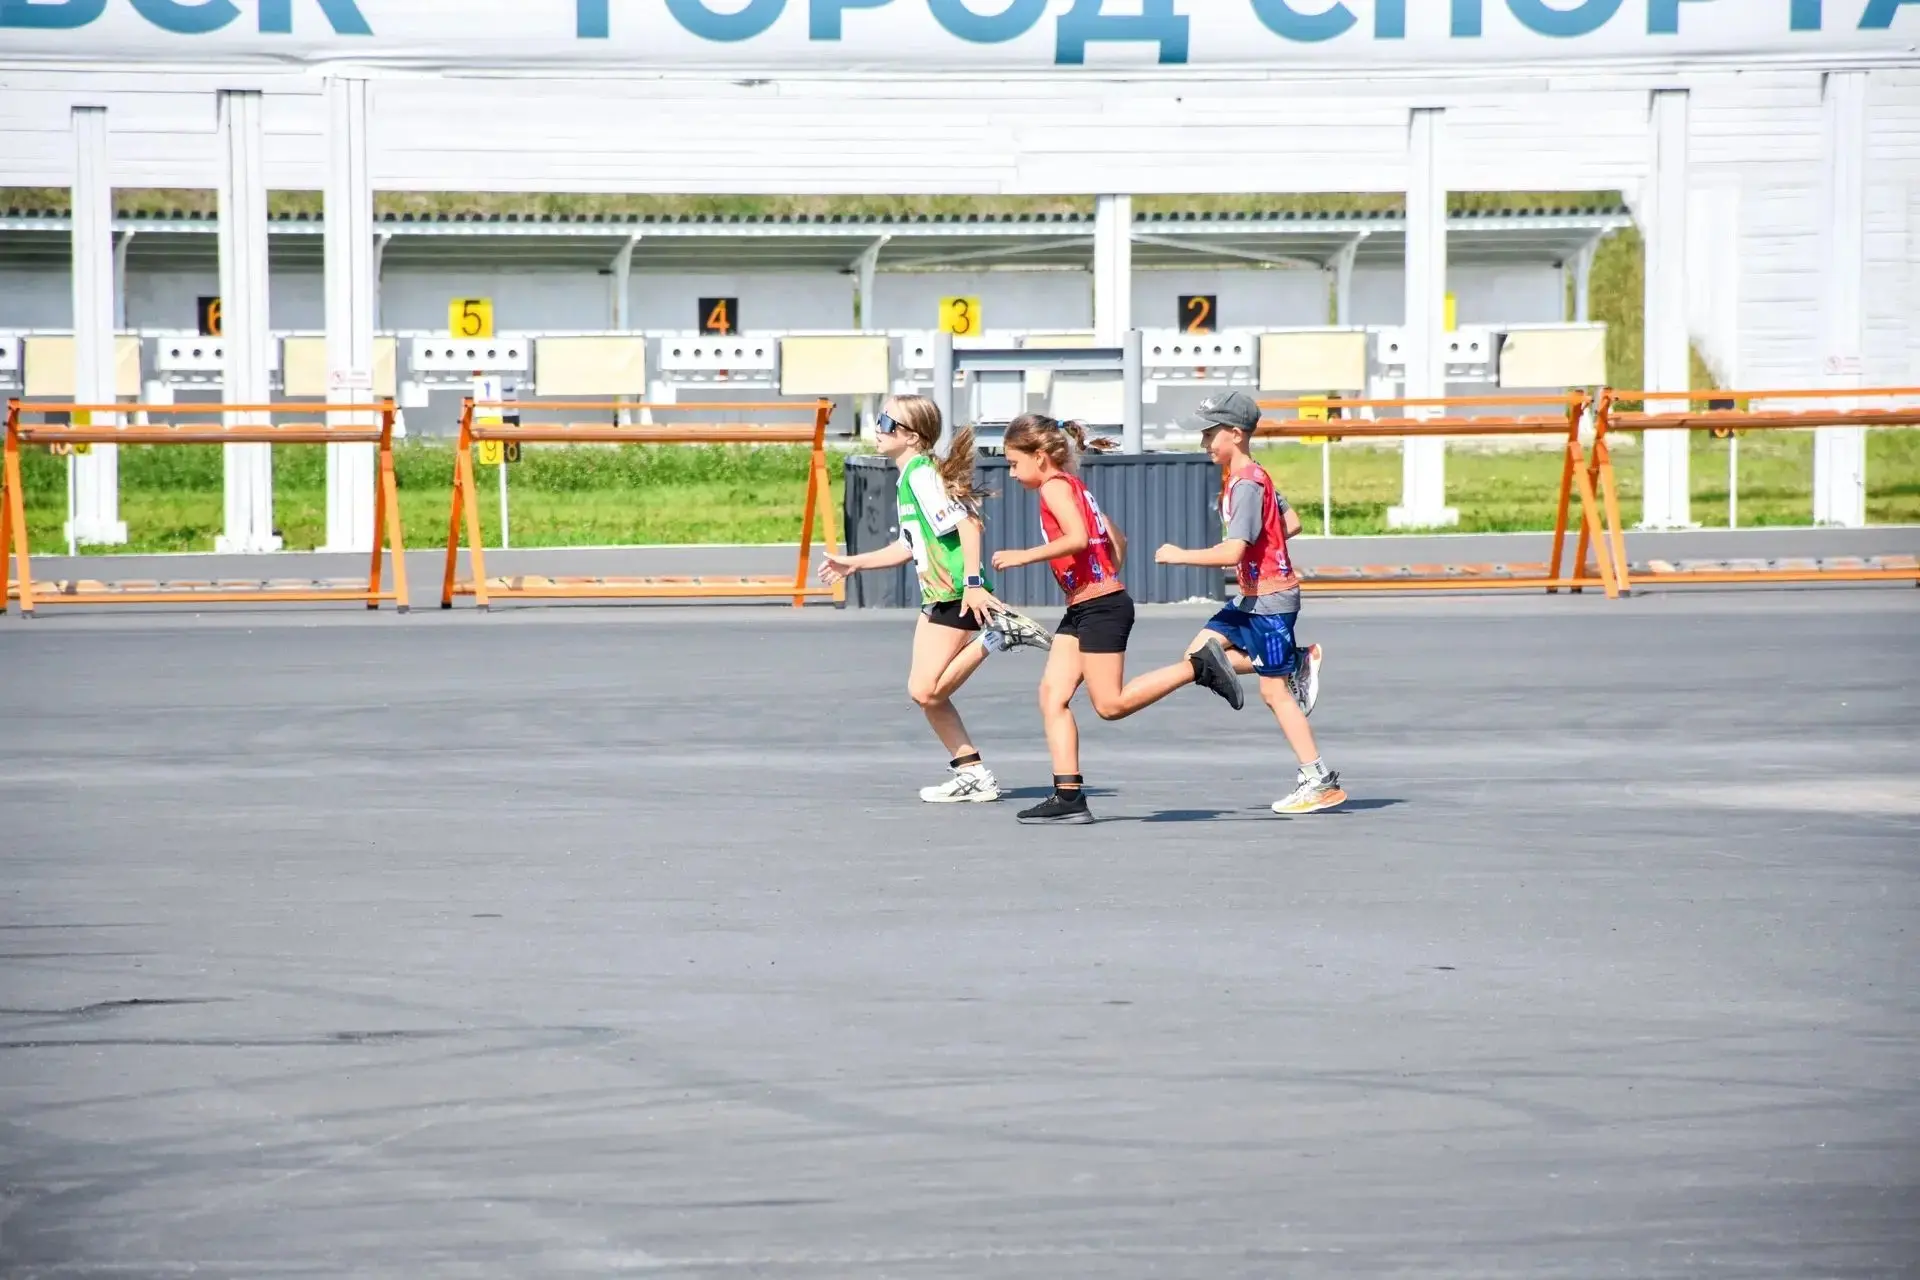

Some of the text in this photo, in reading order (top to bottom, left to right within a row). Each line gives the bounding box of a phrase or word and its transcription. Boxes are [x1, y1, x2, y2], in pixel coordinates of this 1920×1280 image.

[462, 299, 482, 336] 5
[706, 299, 730, 336] 4
[951, 298, 970, 334] 3
[1187, 296, 1210, 335] 2
